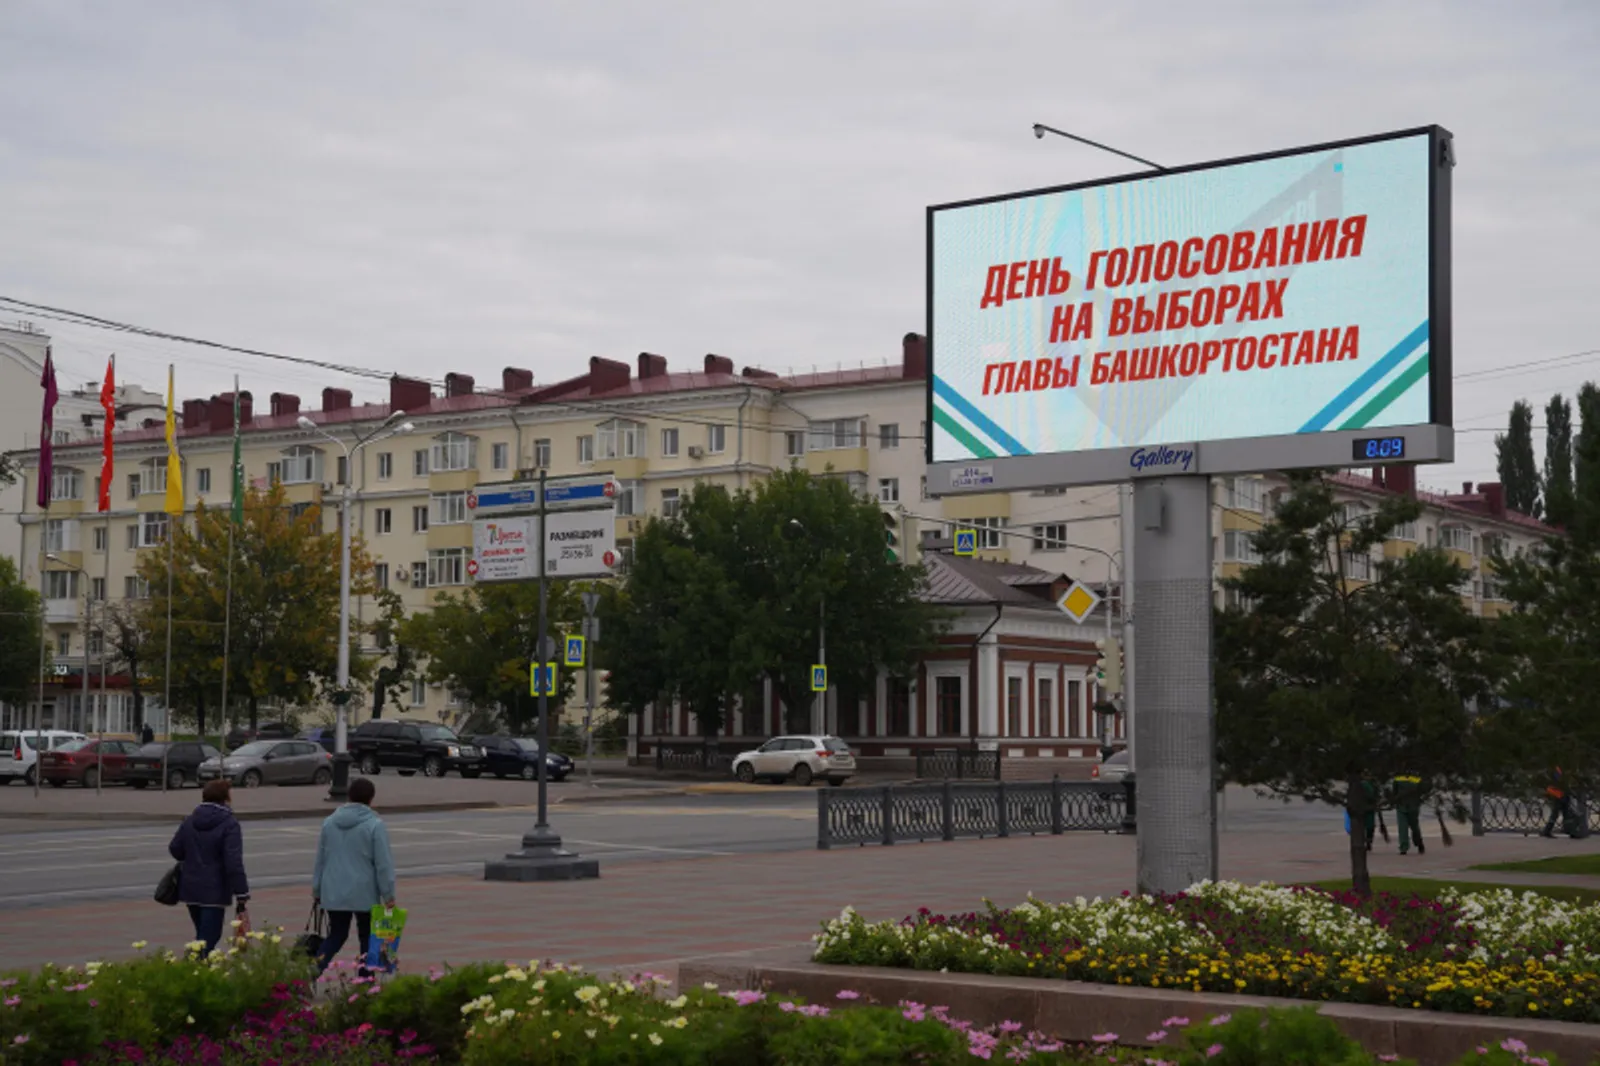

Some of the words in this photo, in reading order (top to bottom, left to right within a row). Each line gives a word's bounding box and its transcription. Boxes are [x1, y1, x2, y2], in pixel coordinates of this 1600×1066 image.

[981, 257, 1071, 309] ДЕНЬ
[1086, 215, 1367, 290] ГОЛОСОВАНИЯ
[1049, 302, 1093, 343] НА
[1108, 278, 1289, 337] ВЫБОРАХ
[982, 355, 1081, 396] ГЛАВЫ
[1090, 325, 1360, 386] БАШКОРТОСТАНА
[1130, 446, 1193, 471] Gallery
